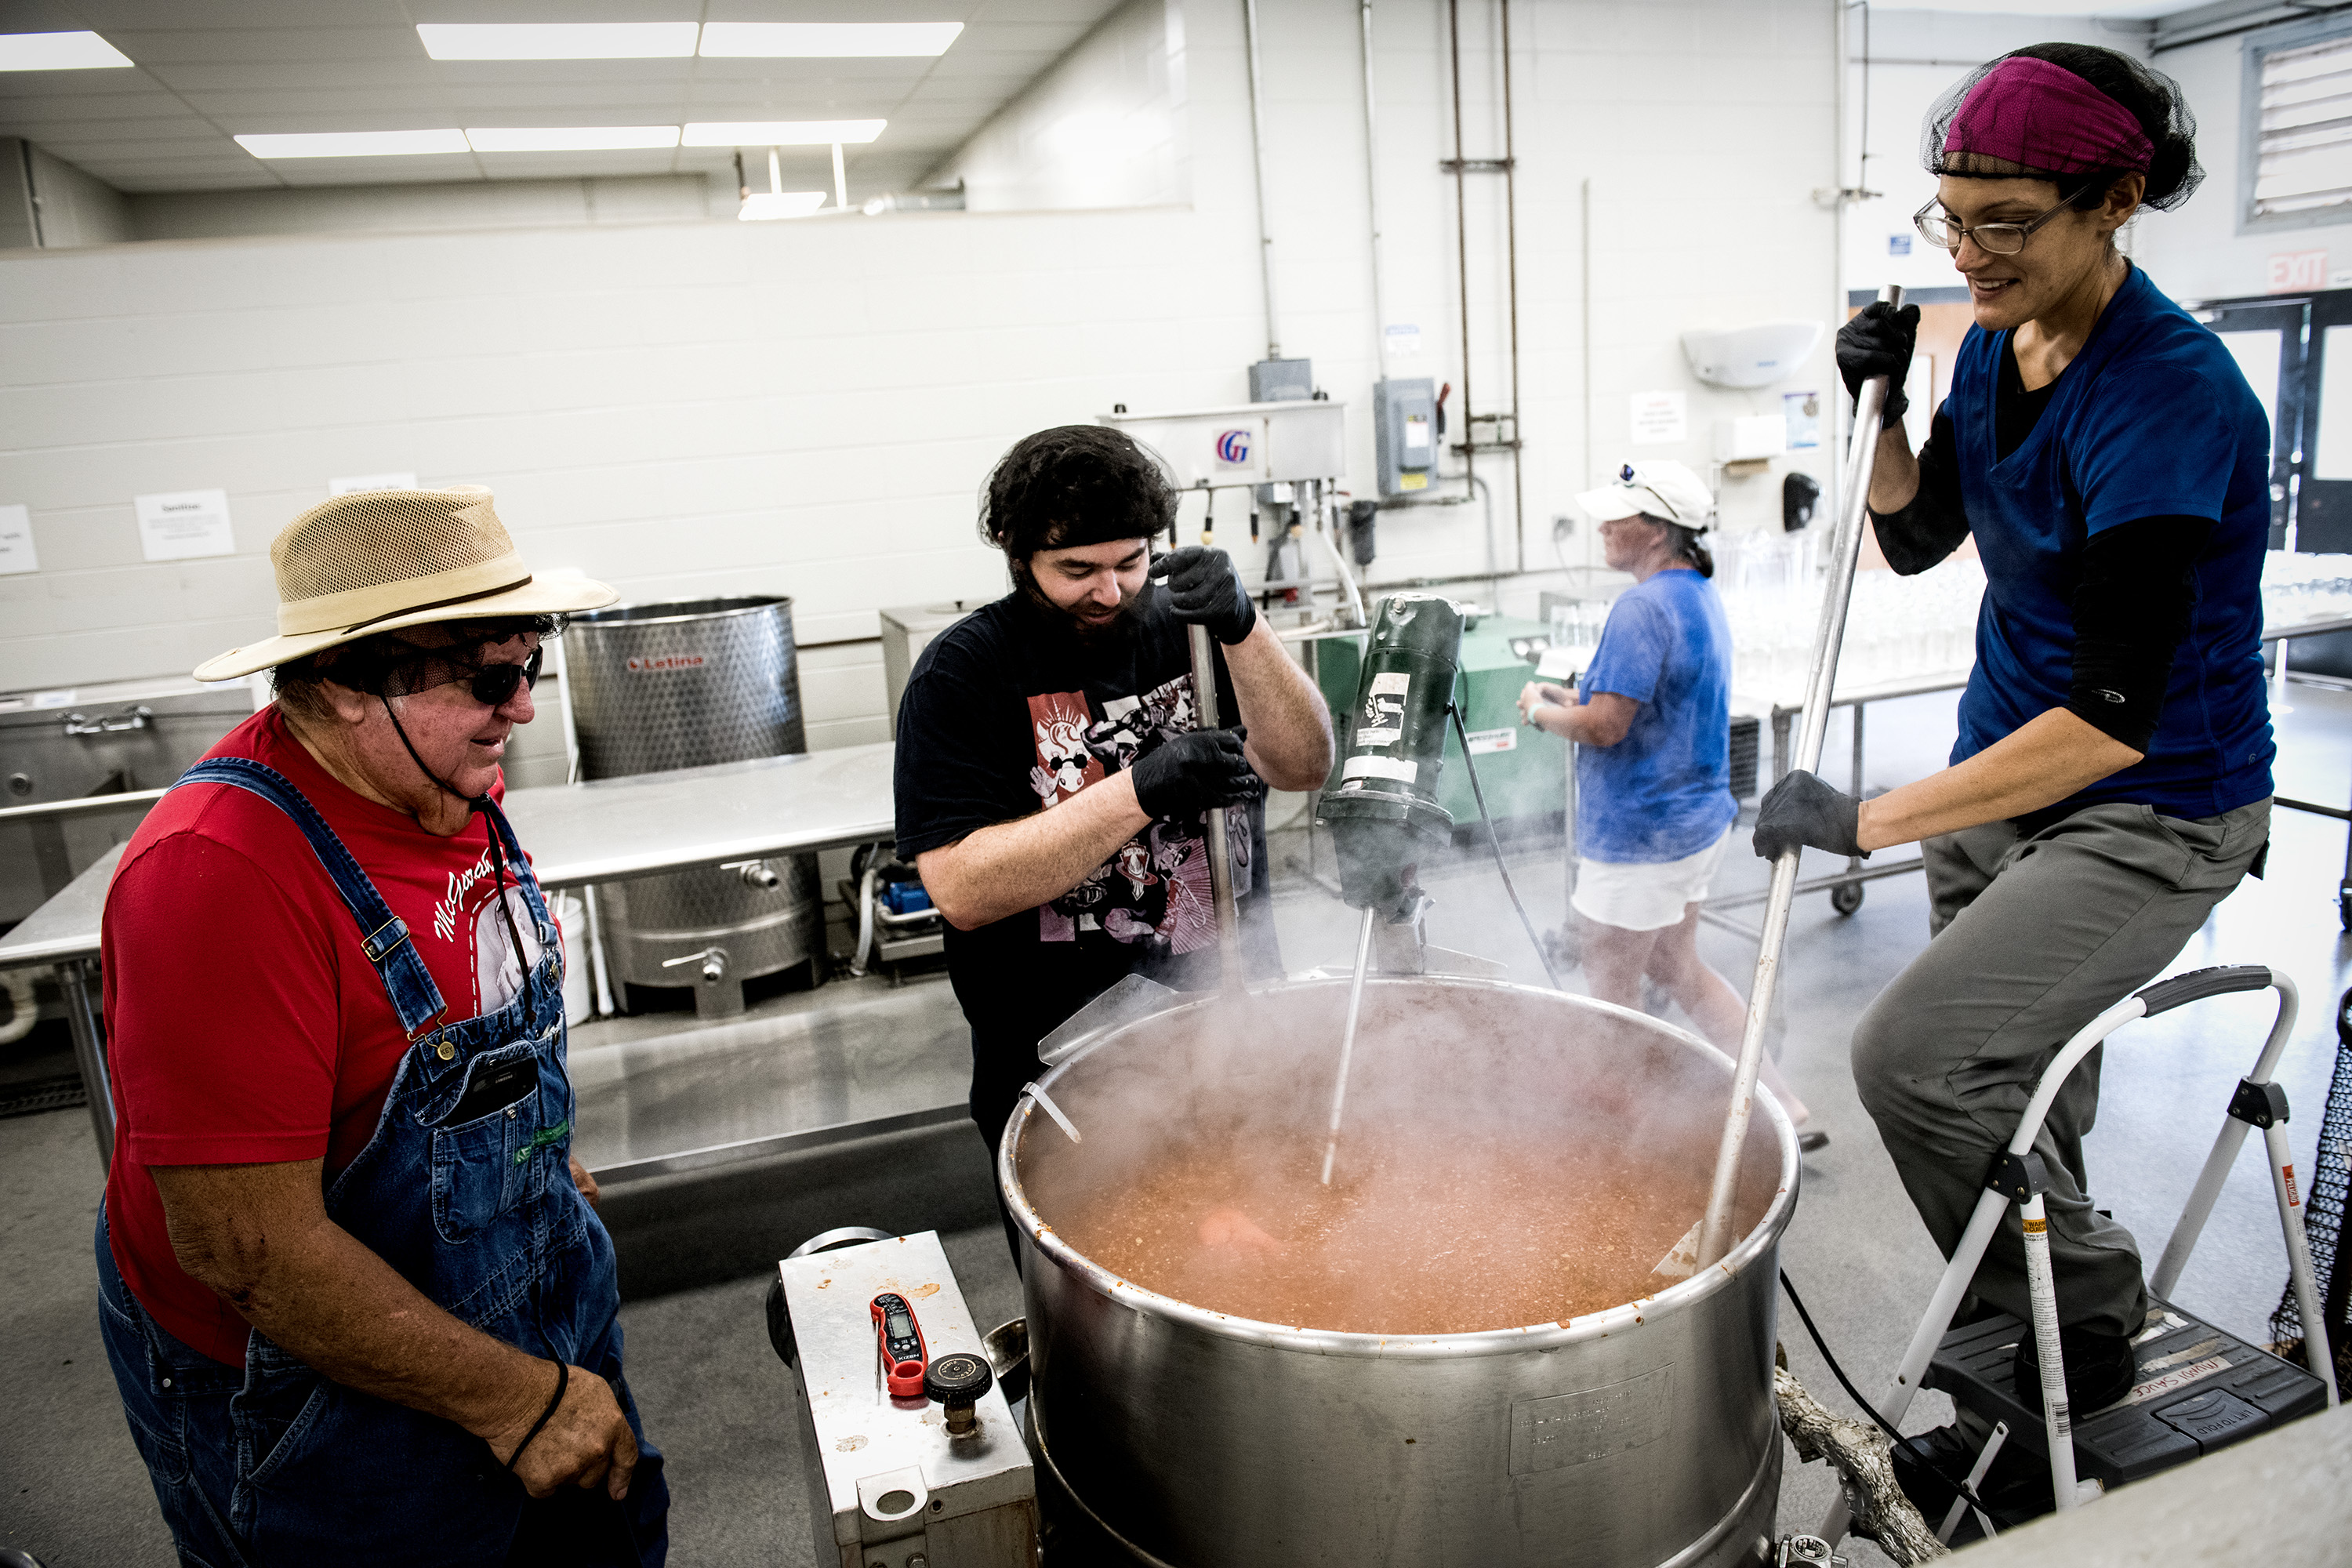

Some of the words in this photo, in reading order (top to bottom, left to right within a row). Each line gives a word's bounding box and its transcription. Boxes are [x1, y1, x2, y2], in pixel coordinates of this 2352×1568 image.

[2267, 252, 2327, 289] EXIT
[440, 1046, 453, 1056] KEY
[495, 1074, 514, 1084] SAMSUNG
[517, 1144, 533, 1163] KE
[2287, 1178, 2296, 1203] PELIGRO
[2179, 1359, 2219, 1381] MUNDI
[2132, 1376, 2179, 1397] SAUCE
[2234, 1410, 2254, 1423] LIFT
[2197, 1421, 2224, 1435] FOLD
